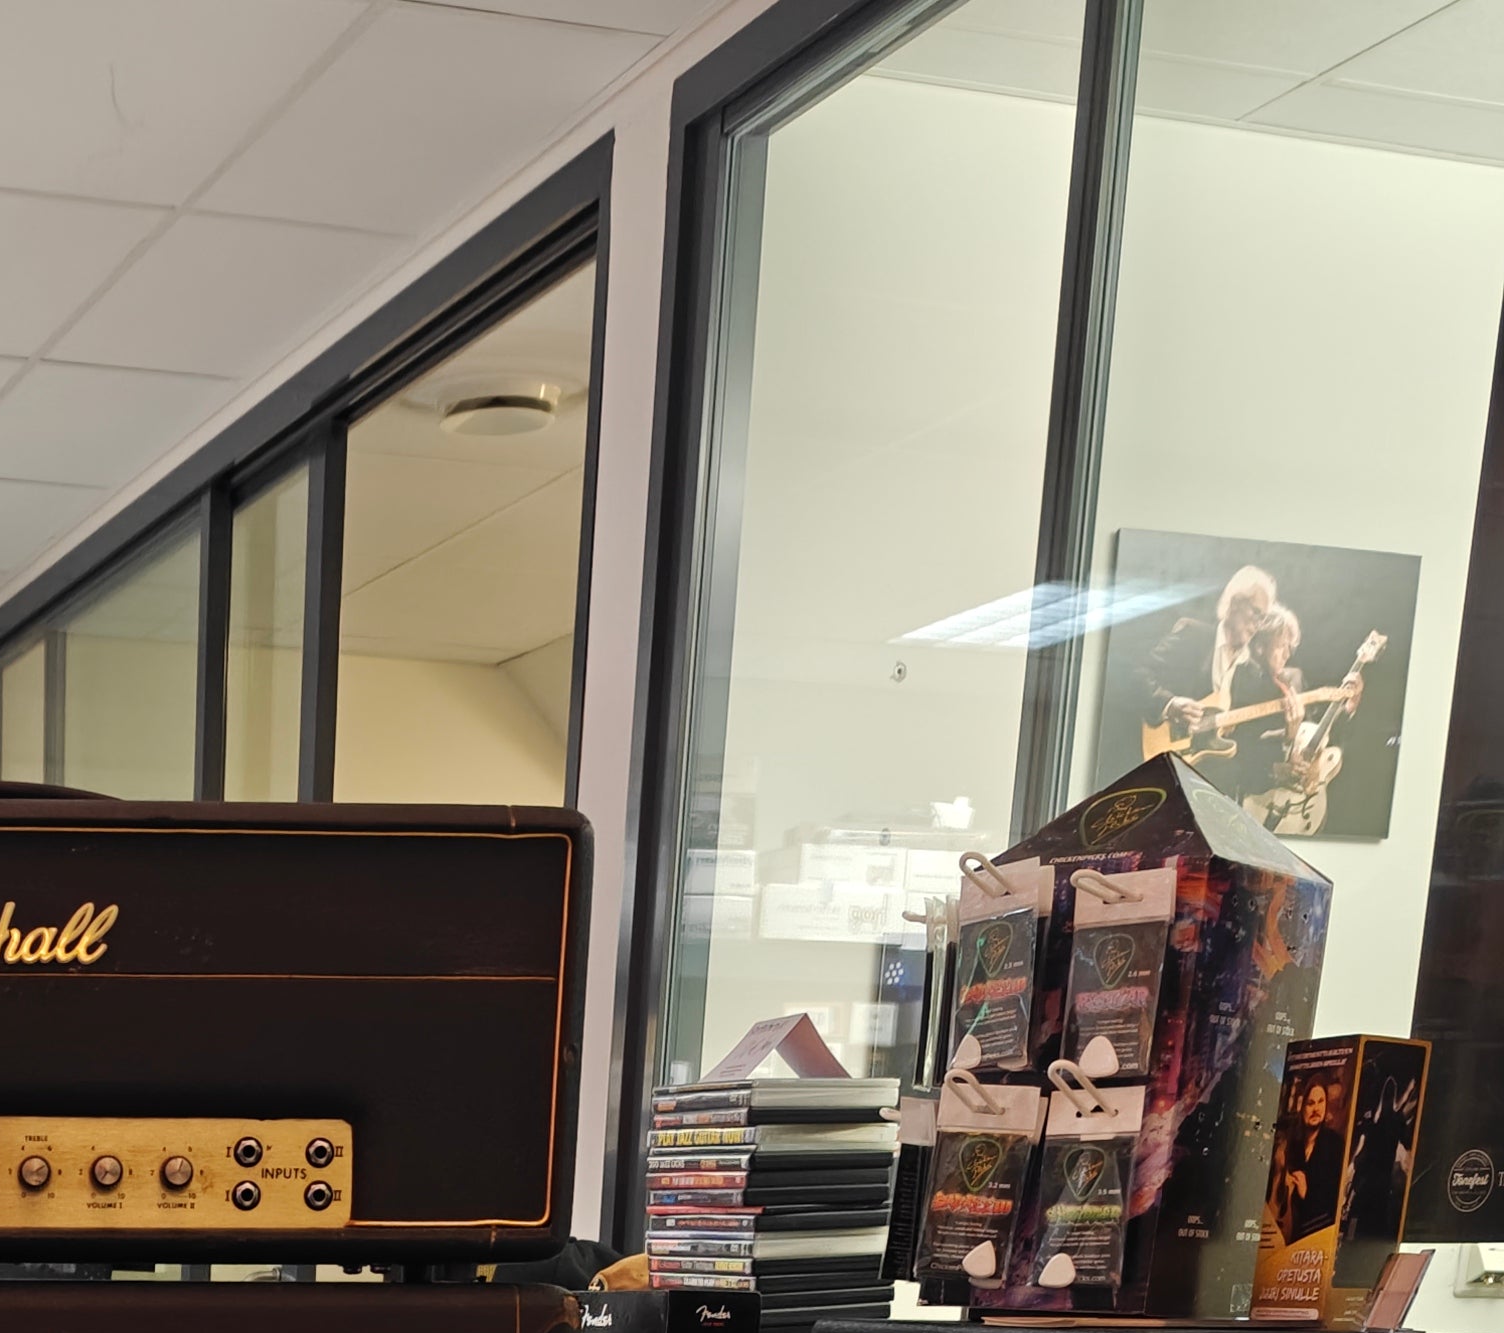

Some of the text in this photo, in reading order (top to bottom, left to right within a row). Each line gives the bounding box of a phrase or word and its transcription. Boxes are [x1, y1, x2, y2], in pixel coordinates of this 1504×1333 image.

[261, 1167, 307, 1179] INPUTS
[580, 1304, 612, 1329] Fender
[696, 1304, 731, 1322] Fender
